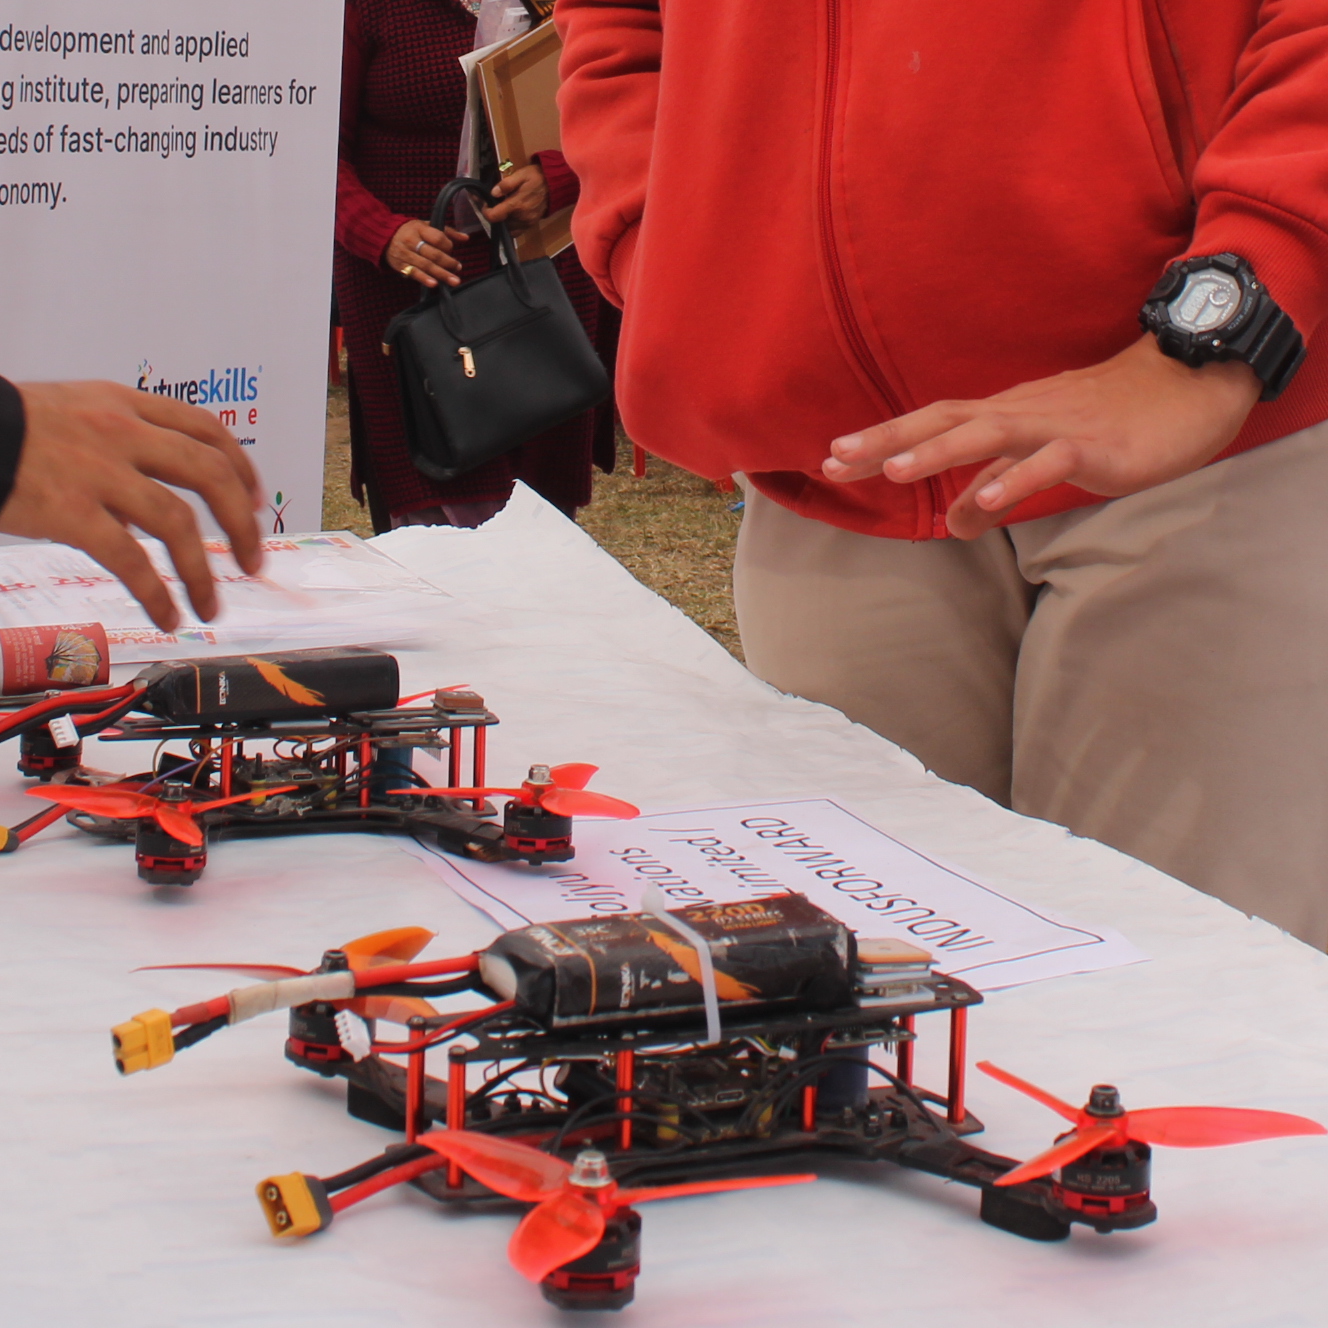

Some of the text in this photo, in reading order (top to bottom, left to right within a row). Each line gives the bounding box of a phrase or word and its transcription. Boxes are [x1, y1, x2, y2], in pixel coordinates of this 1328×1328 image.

[0, 23, 135, 59] development
[141, 29, 170, 56] and
[174, 31, 249, 63] applied
[20, 74, 109, 109] institute,
[116, 77, 204, 110] preparing
[212, 78, 283, 105] learners
[289, 79, 317, 105] for
[33, 124, 54, 153] of
[59, 124, 197, 159] fast-changing
[204, 125, 278, 157] industry
[137, 367, 257, 405] ftureskills
[549, 873, 628, 913] oljyu
[609, 847, 715, 909] vations
[740, 817, 996, 952] INDUSFORWARD
[686, 902, 766, 923] 2200
